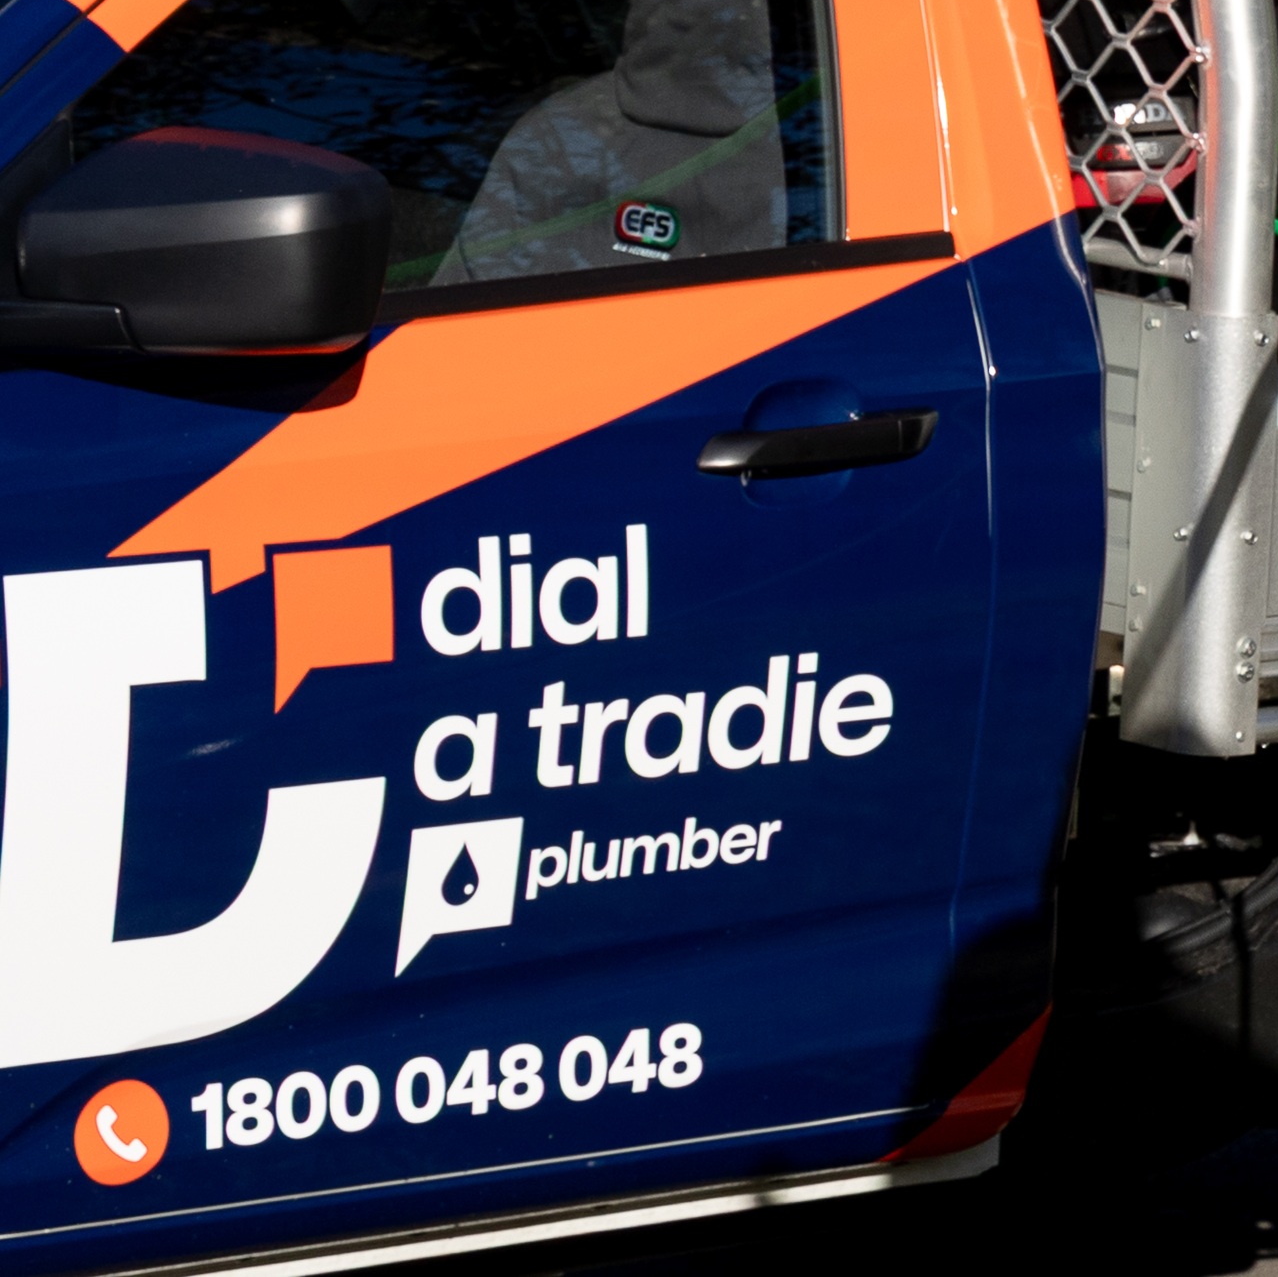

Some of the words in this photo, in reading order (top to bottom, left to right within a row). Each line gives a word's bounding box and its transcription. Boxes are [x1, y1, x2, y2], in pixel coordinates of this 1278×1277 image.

[624, 208, 671, 238] EFS
[420, 523, 649, 656] dial
[413, 712, 498, 802] a
[528, 652, 894, 788] tradie
[524, 816, 782, 900] plumber
[190, 1064, 381, 1151] 1800
[395, 1042, 545, 1125] 048
[558, 1021, 704, 1103] 048
